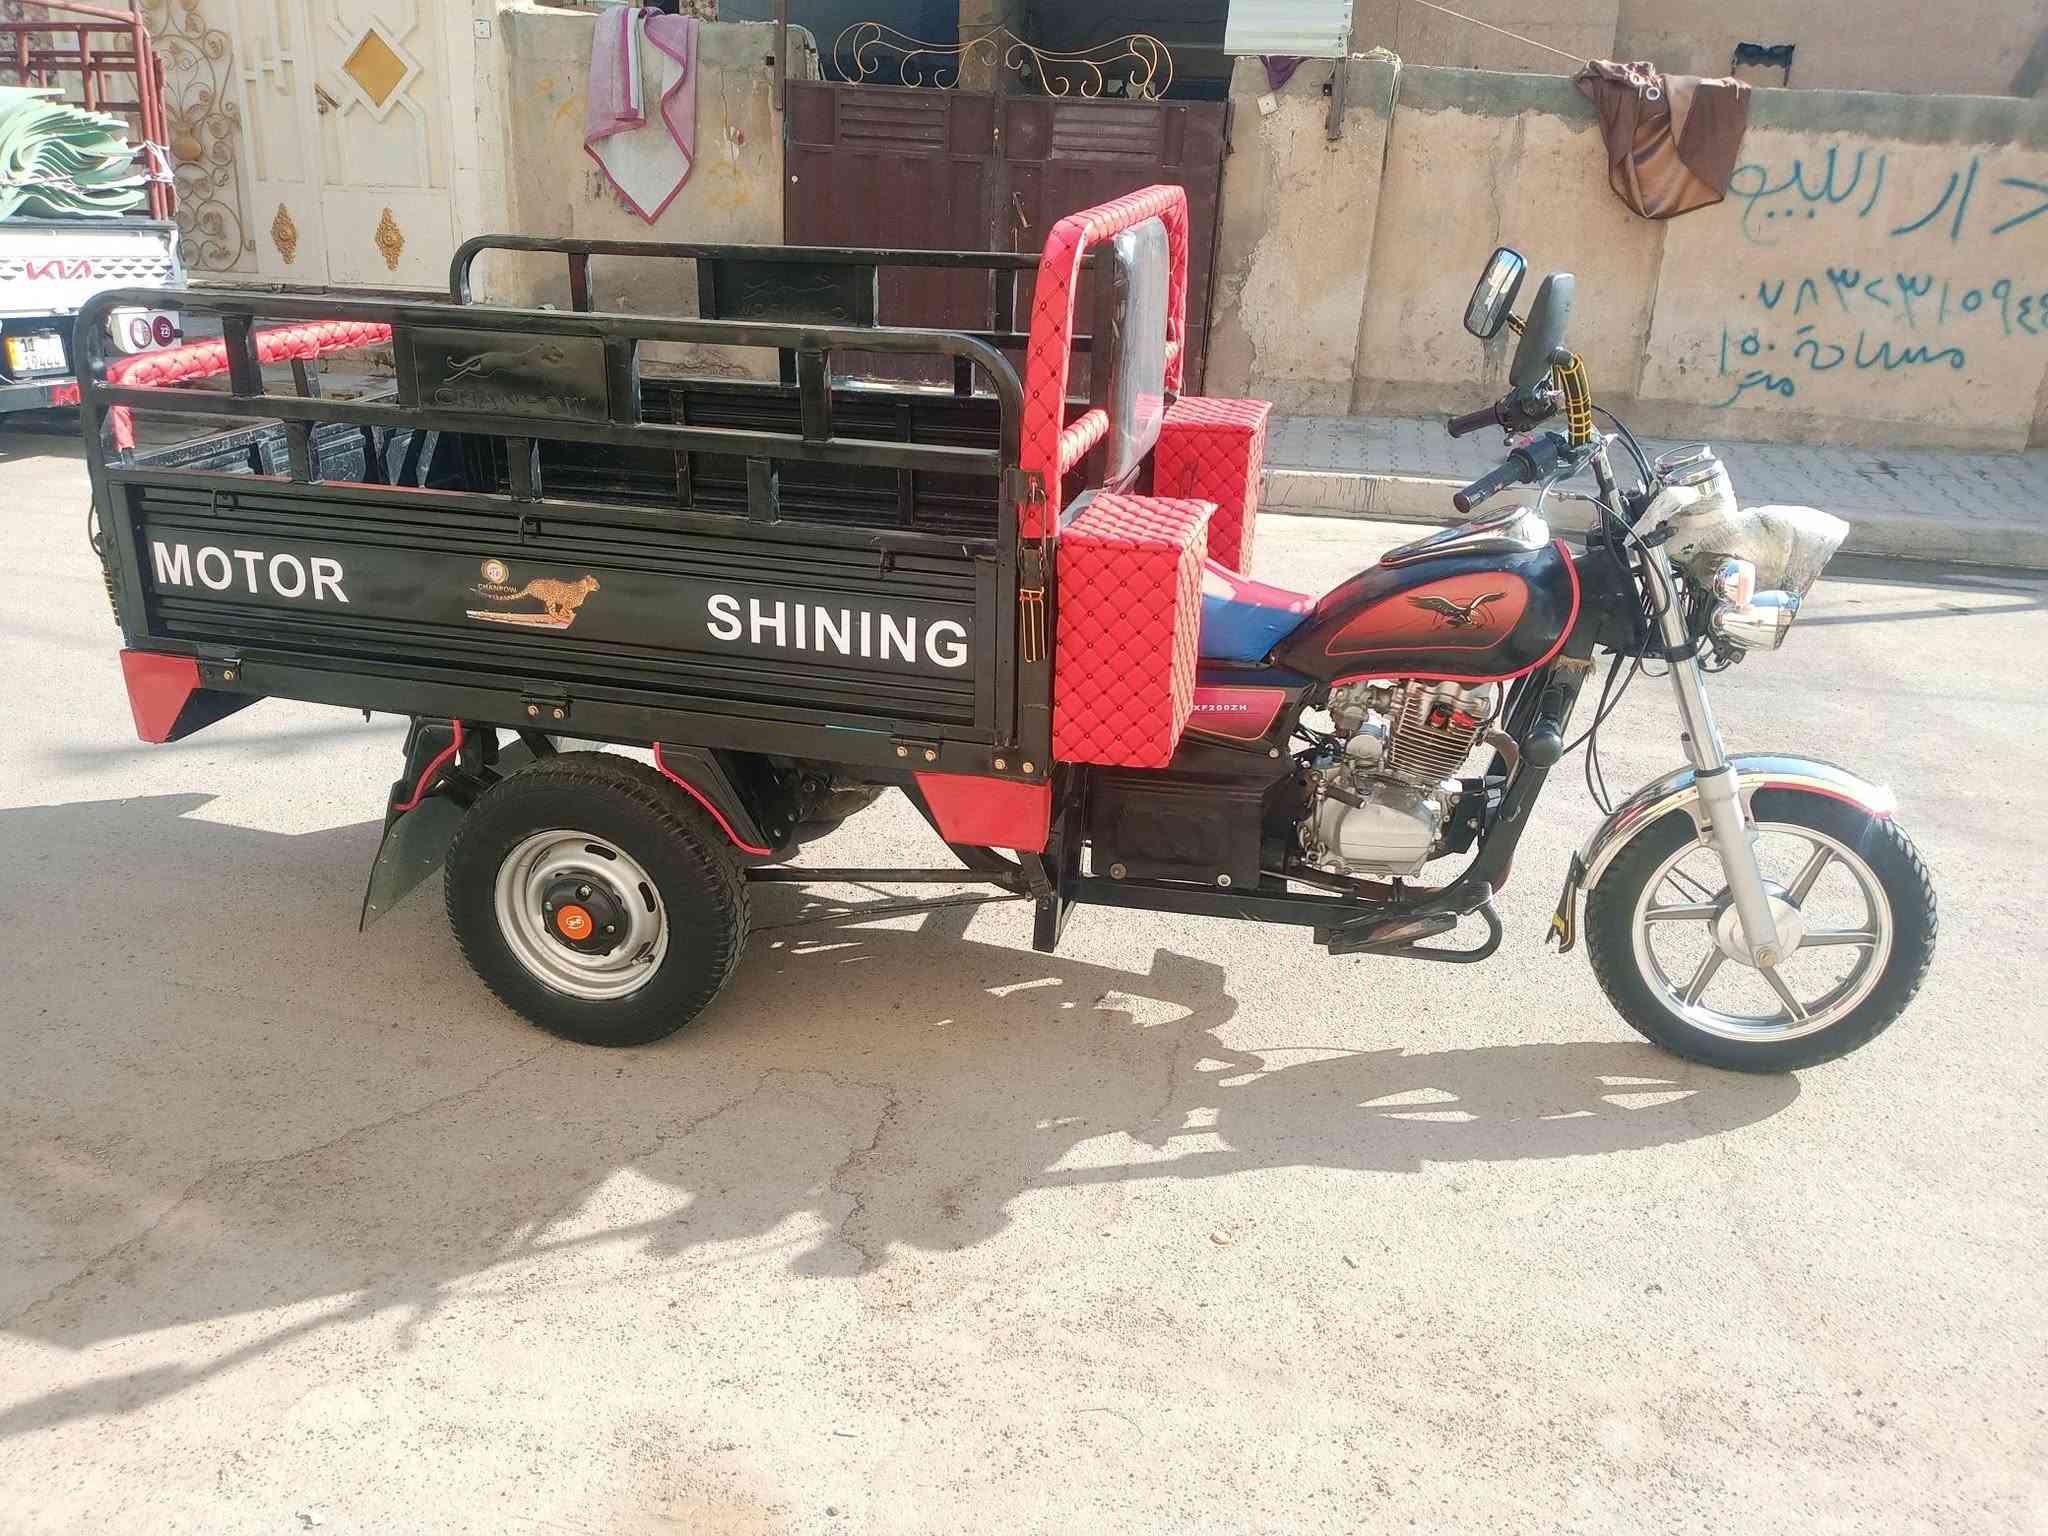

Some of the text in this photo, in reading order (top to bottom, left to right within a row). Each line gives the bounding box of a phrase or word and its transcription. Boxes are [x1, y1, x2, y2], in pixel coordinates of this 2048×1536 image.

[1890, 155, 2048, 242] دار
[26, 260, 92, 280] KIA
[1711, 369, 1796, 409] متر
[153, 541, 349, 603] MOTOR
[706, 594, 968, 668] SHINING
